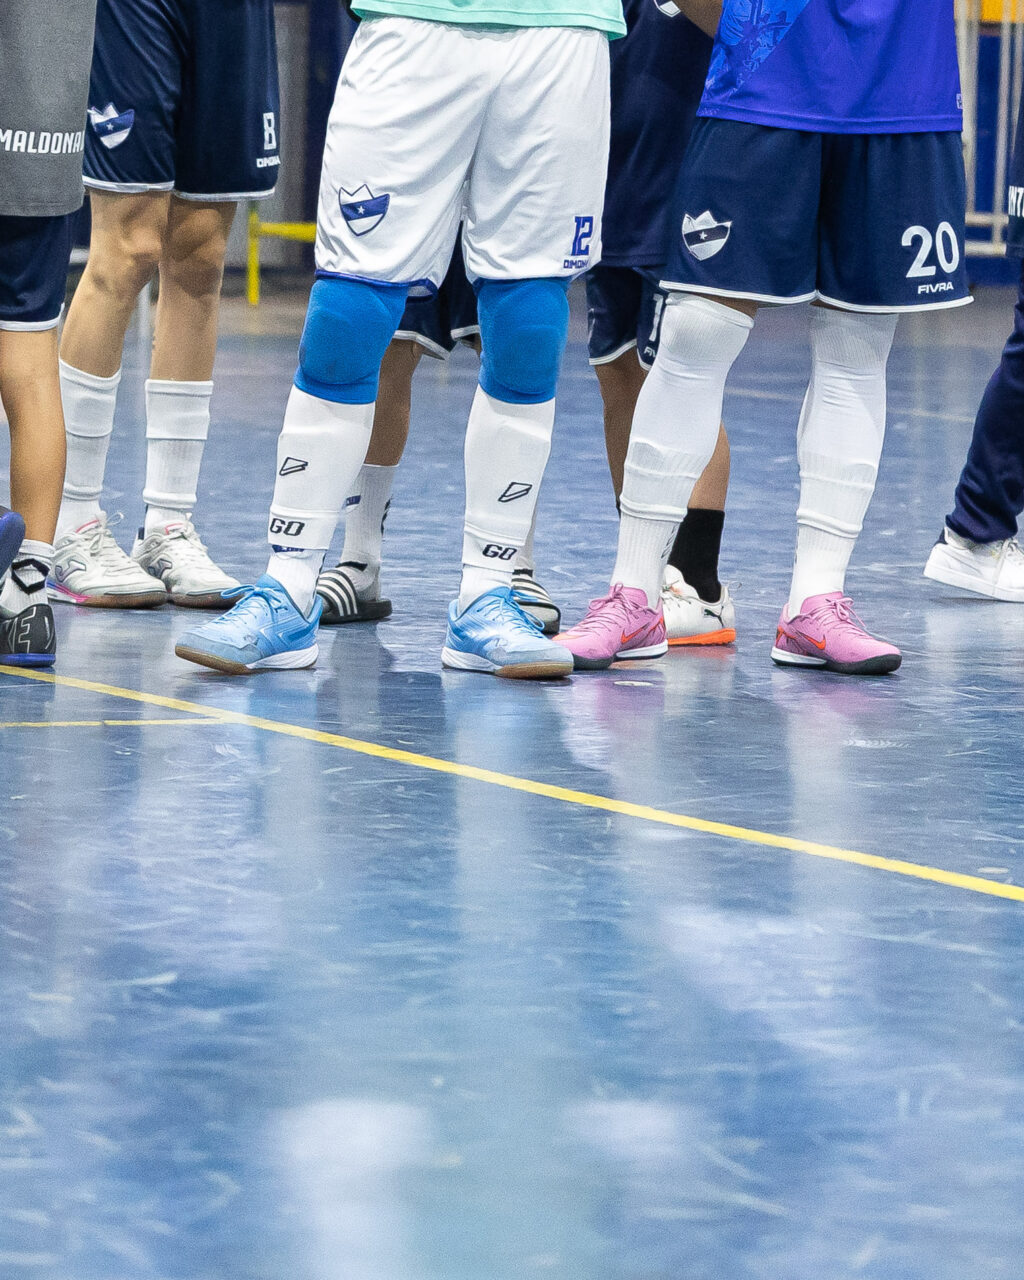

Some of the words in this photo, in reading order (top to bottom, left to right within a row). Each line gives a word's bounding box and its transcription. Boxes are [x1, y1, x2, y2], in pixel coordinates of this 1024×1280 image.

[263, 112, 277, 150] 8
[571, 216, 594, 256] 12
[901, 221, 960, 278] 20
[917, 281, 954, 295] FIVRA
[269, 517, 305, 537] GO
[482, 543, 518, 561] GO
